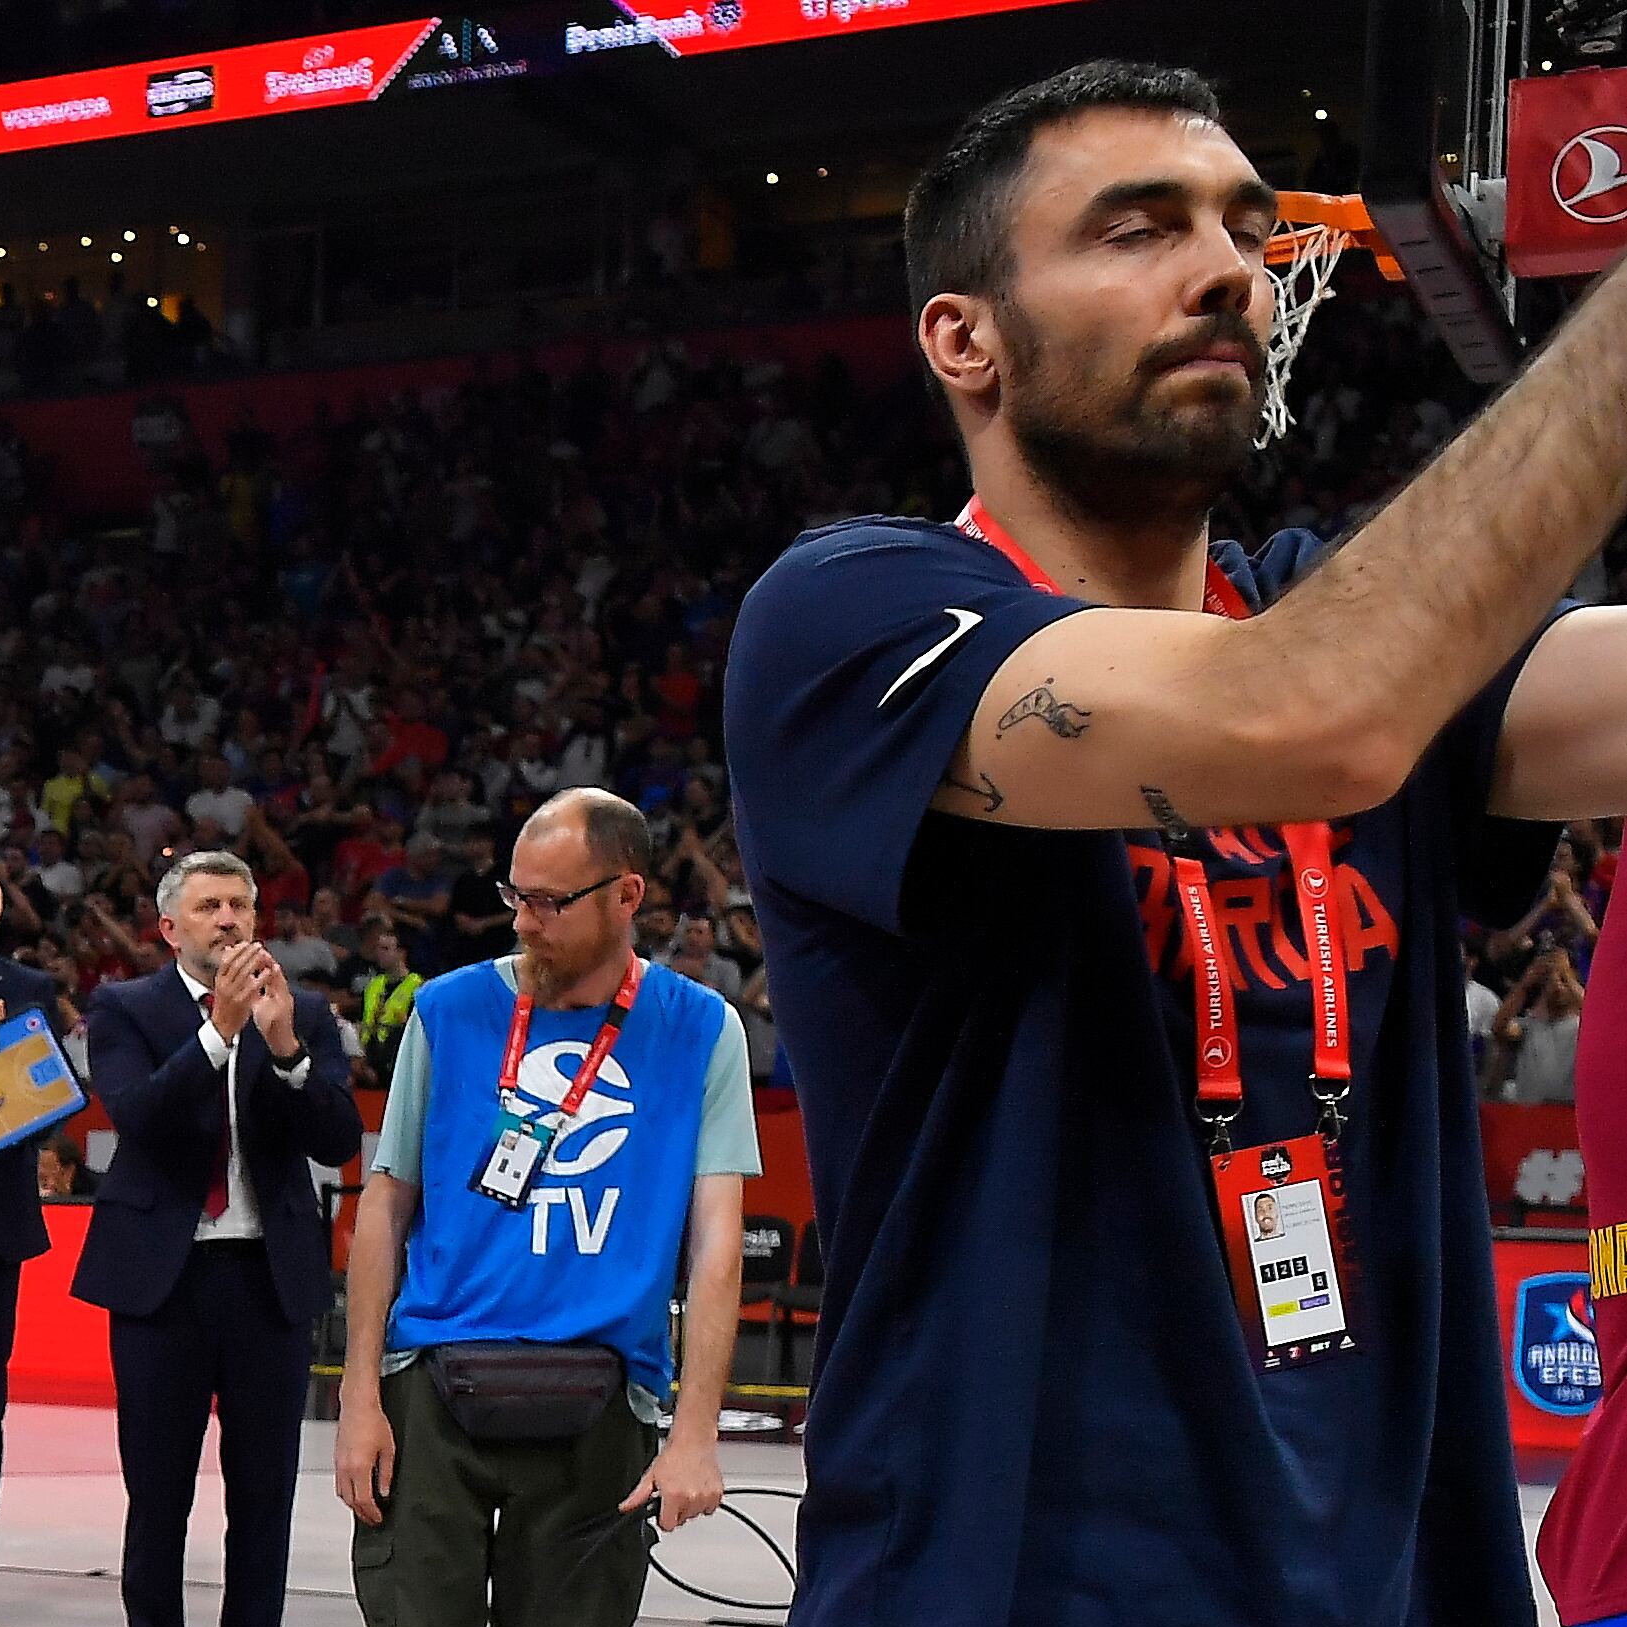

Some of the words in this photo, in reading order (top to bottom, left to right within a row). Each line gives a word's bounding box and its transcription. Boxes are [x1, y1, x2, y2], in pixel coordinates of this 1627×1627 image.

[1187, 884, 1215, 955] AIRLINES
[1313, 902, 1333, 973] TURKISH
[1204, 957, 1223, 1030] TURKISH
[1321, 976, 1339, 1048] AIRLINES
[527, 1187, 621, 1255] TV
